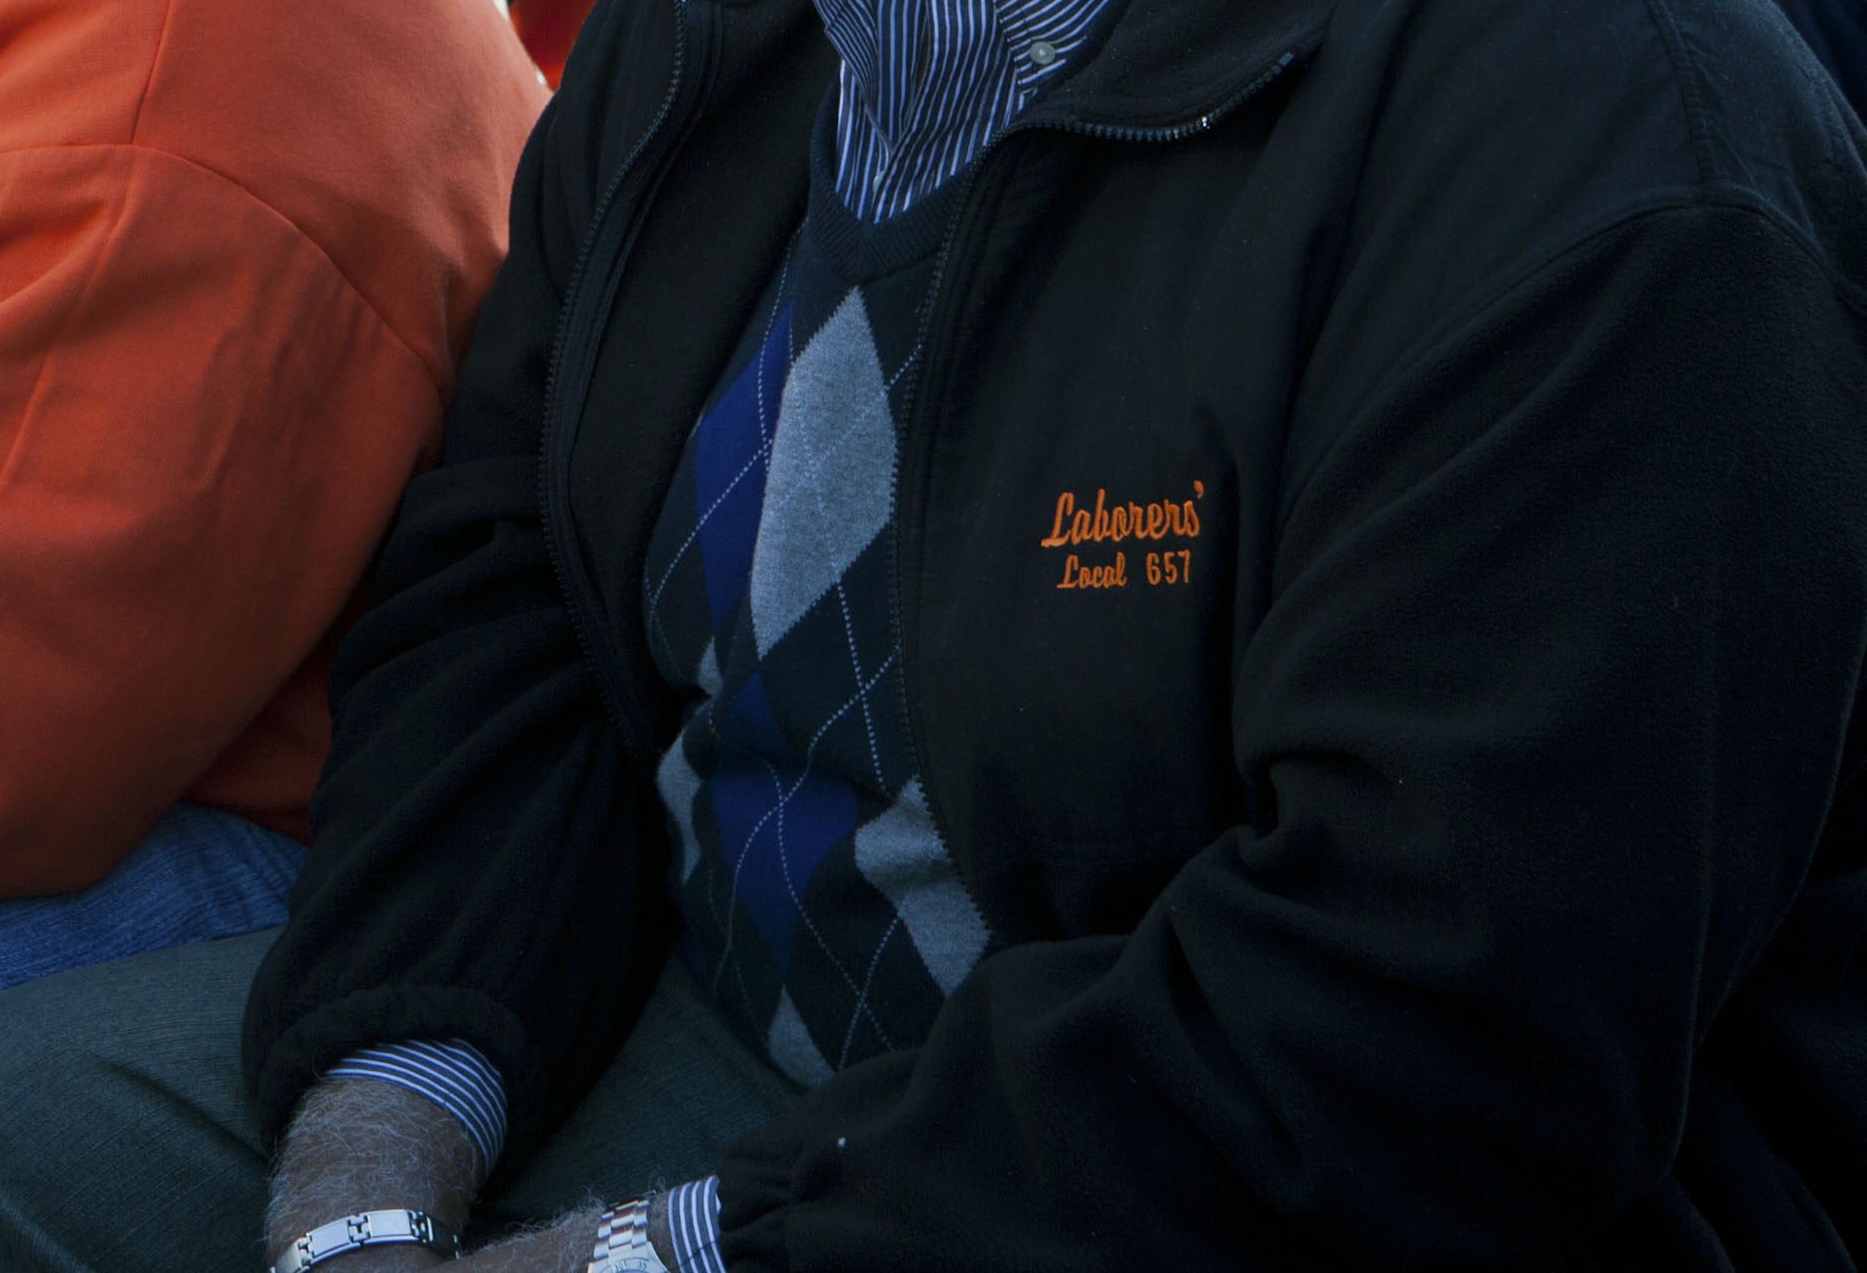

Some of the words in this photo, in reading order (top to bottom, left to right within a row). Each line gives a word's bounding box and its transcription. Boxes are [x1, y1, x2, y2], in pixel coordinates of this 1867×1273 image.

[1040, 480, 1205, 548] Laborers'
[1056, 551, 1127, 589] Local
[1146, 549, 1190, 586] 657
